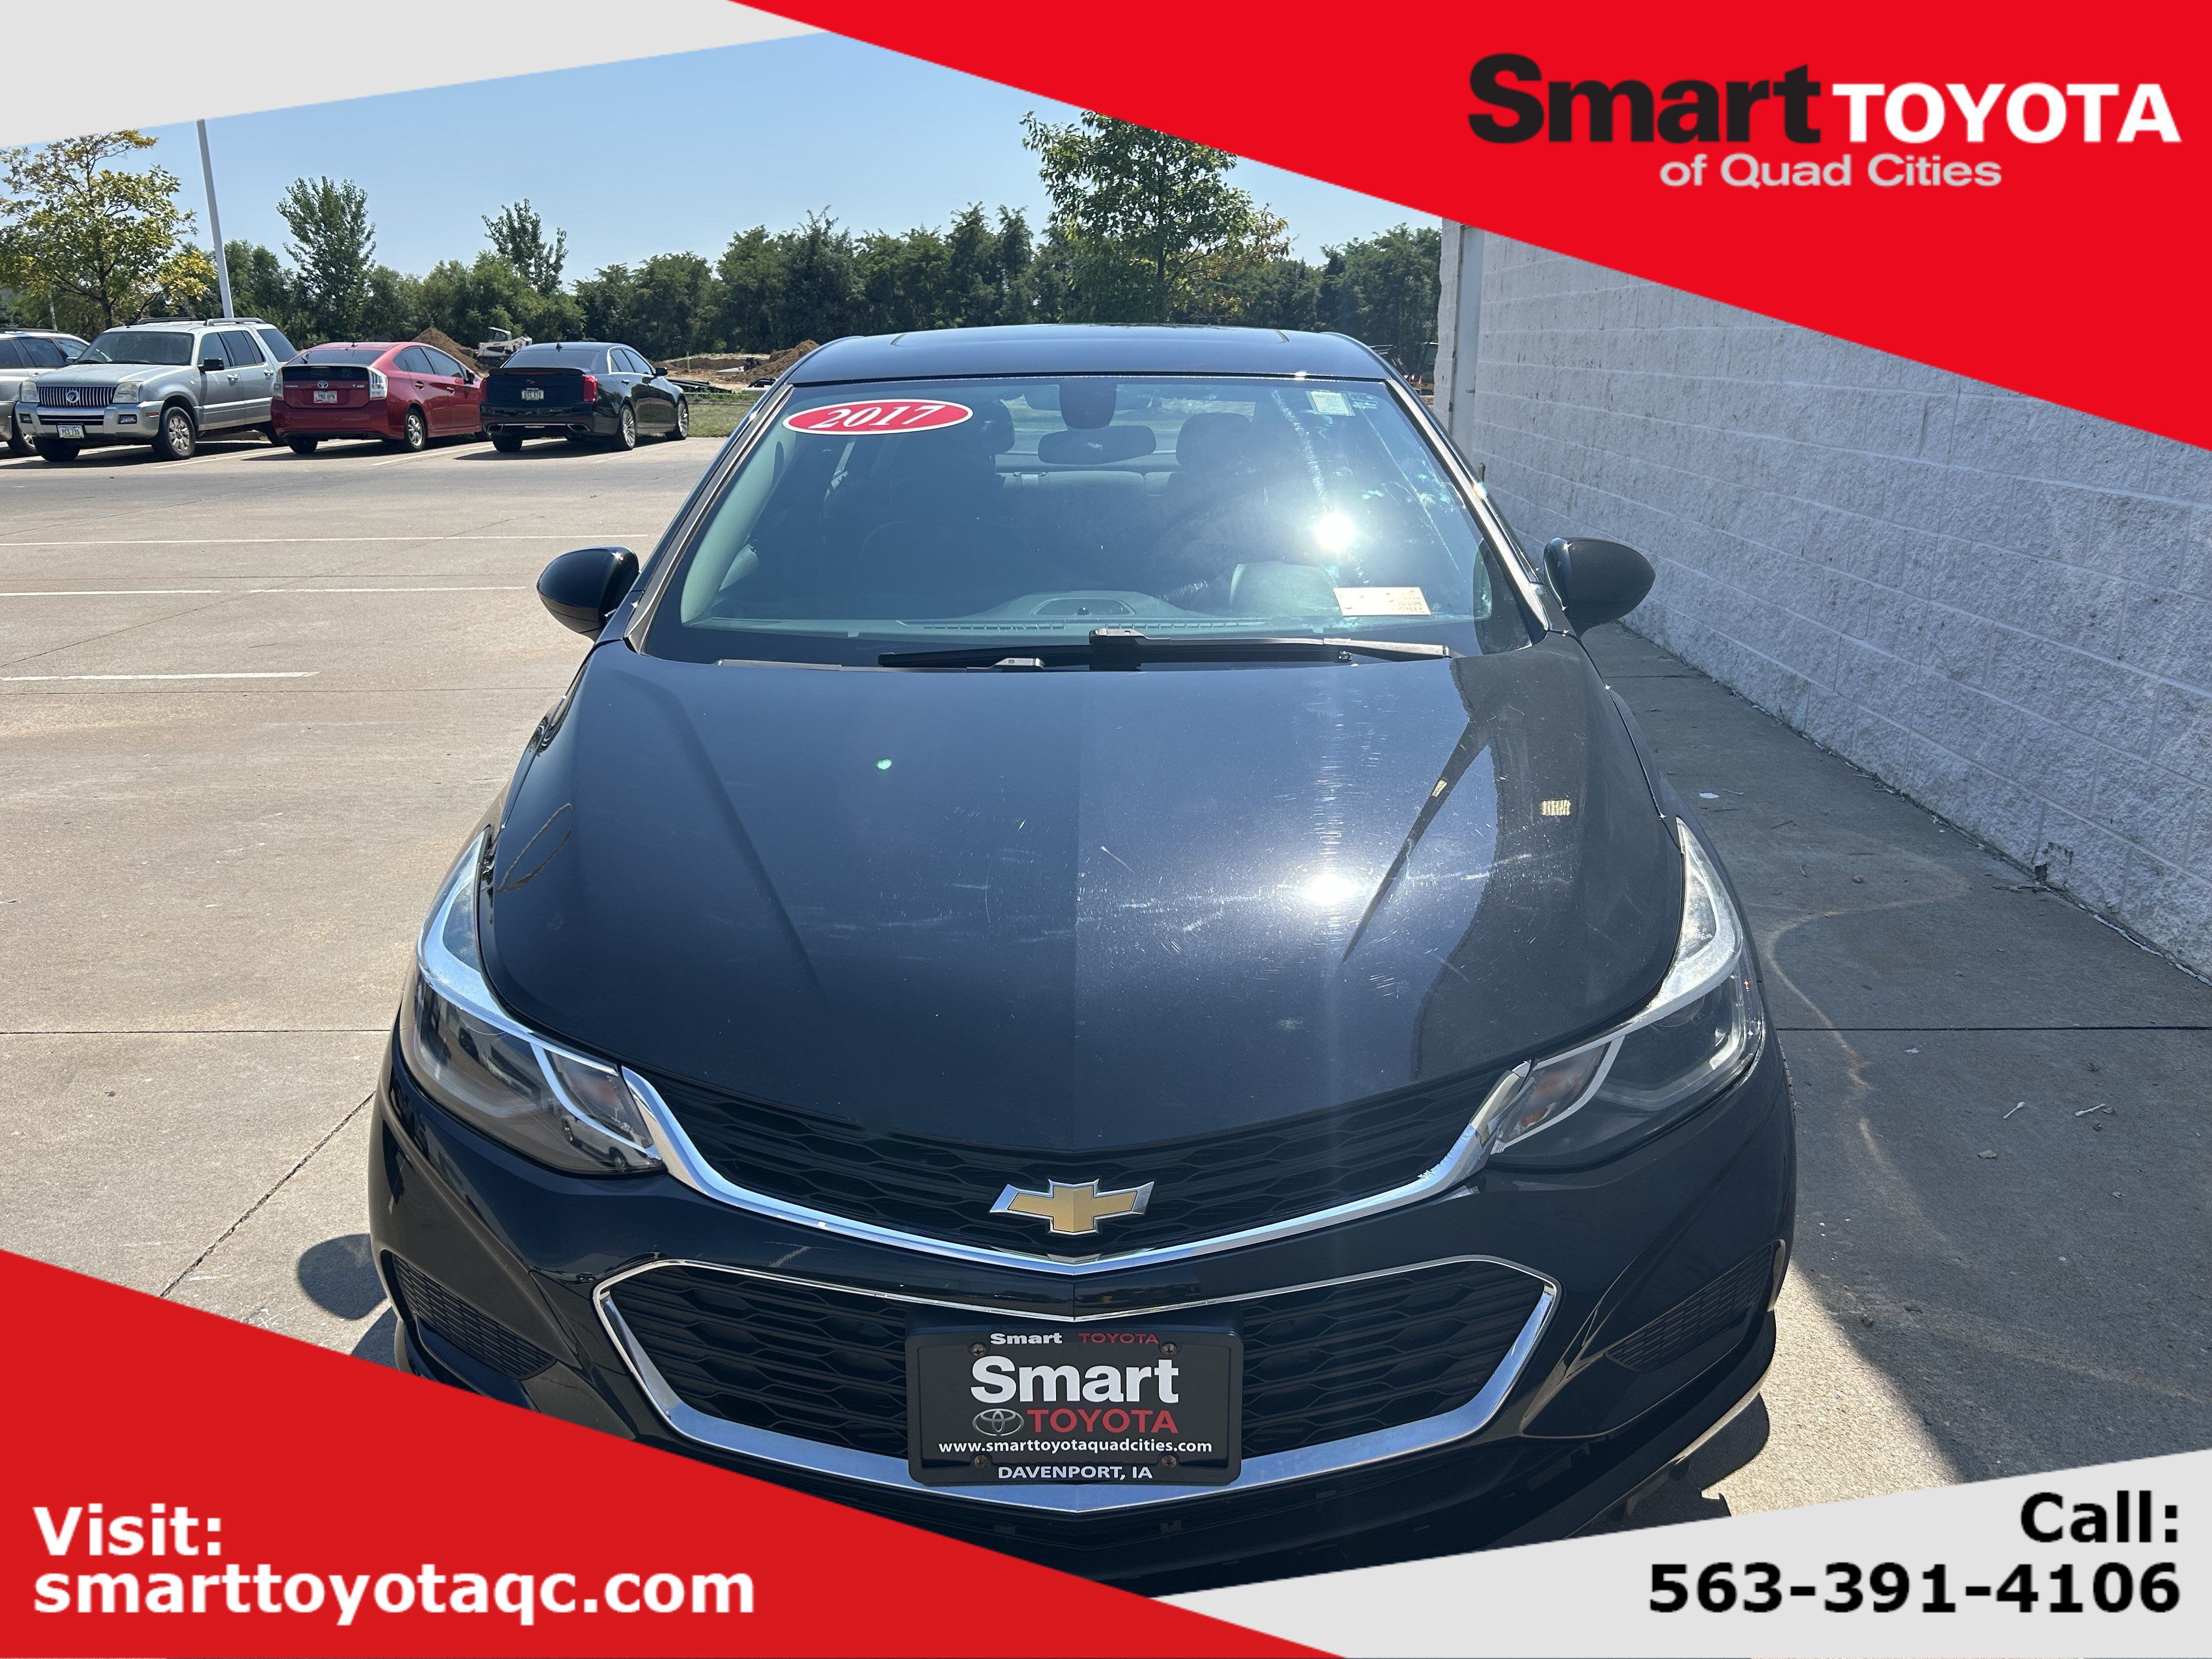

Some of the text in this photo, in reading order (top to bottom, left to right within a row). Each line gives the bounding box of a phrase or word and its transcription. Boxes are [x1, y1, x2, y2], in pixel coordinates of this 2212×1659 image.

[808, 405, 947, 429] 2017
[990, 1333, 1159, 1345] Smart TOYOTA
[970, 1355, 1179, 1403] Smart
[1027, 1408, 1178, 1434] TOYOTA
[939, 1438, 1212, 1454] www.smarttoyotaquadcities.com
[998, 1466, 1153, 1480] DAVENPORT, IA
